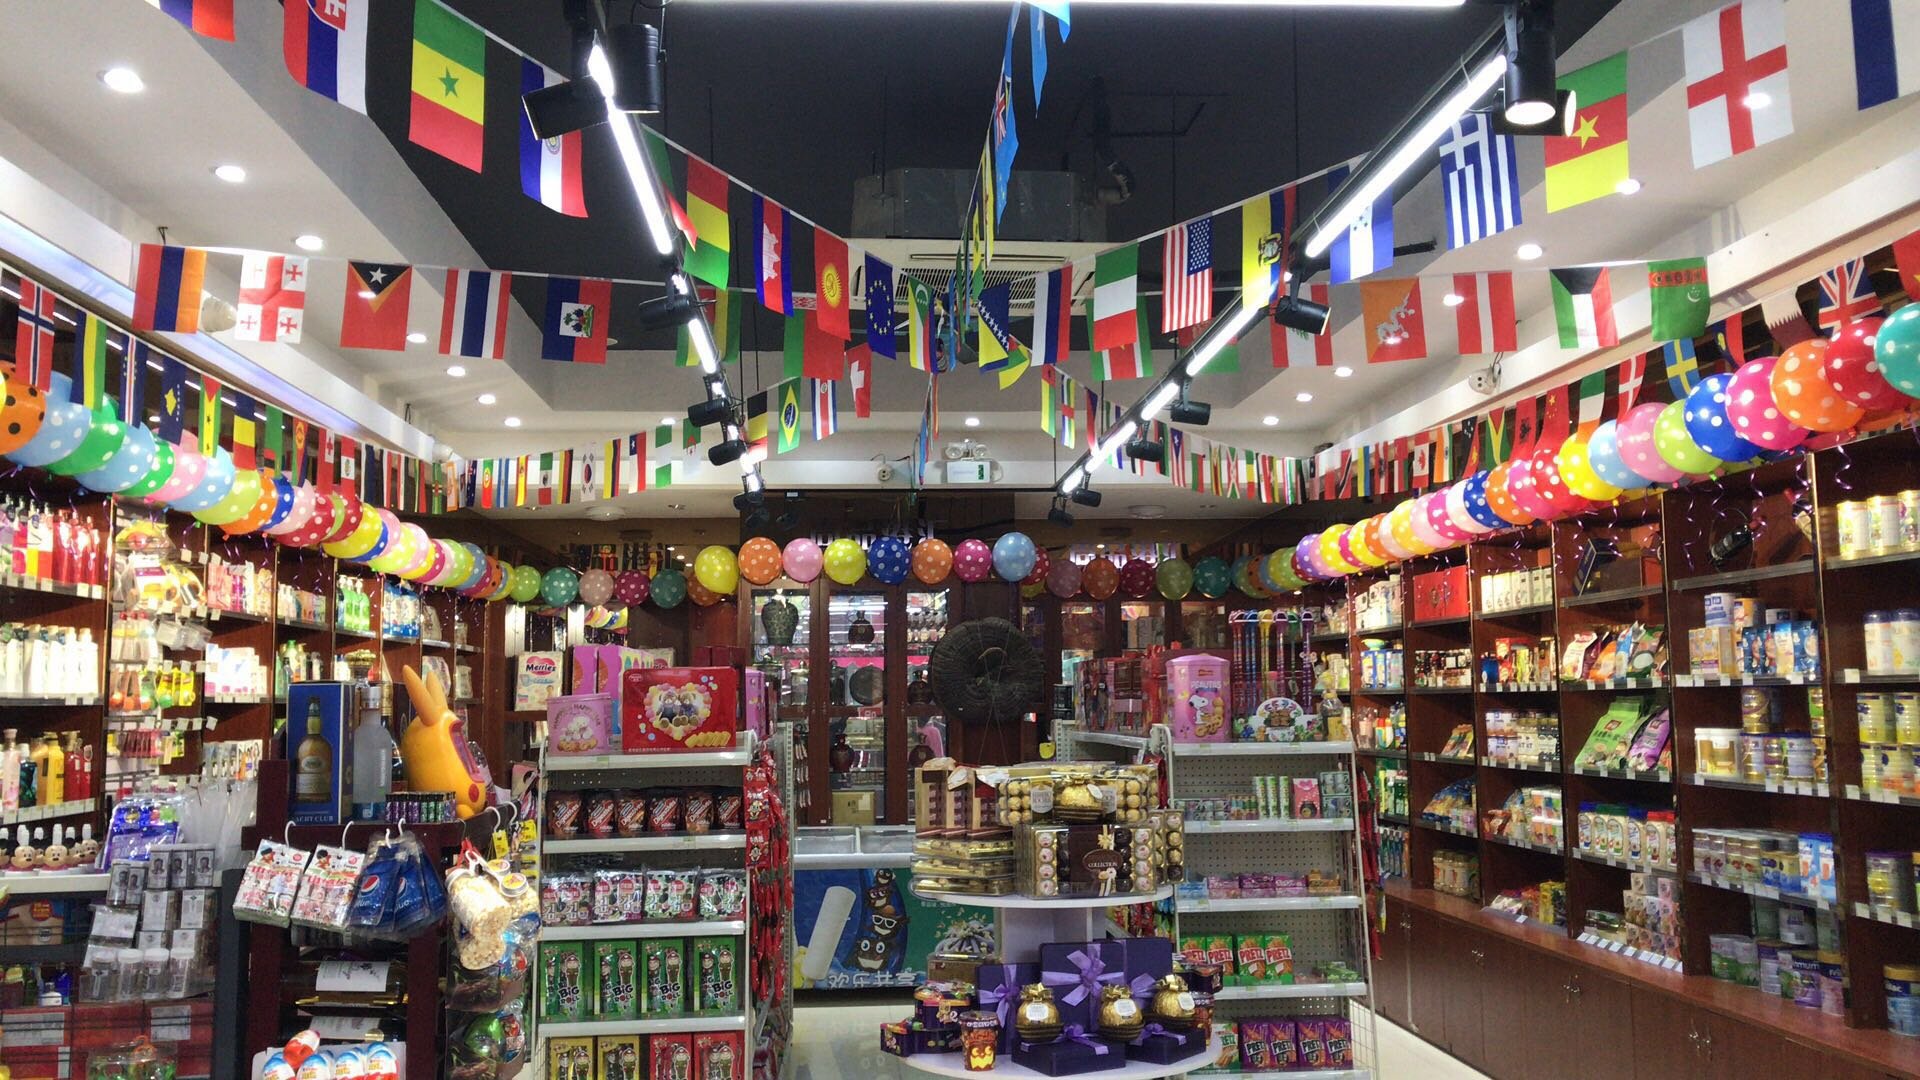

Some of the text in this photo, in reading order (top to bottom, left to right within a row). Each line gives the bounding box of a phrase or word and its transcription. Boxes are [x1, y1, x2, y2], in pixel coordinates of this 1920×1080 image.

[526, 663, 556, 672] Merries
[314, 815, 334, 823] CLUB
[1208, 949, 1233, 963] PRETZ
[1239, 948, 1264, 963] PRETZ
[1266, 947, 1291, 963] PRETZ
